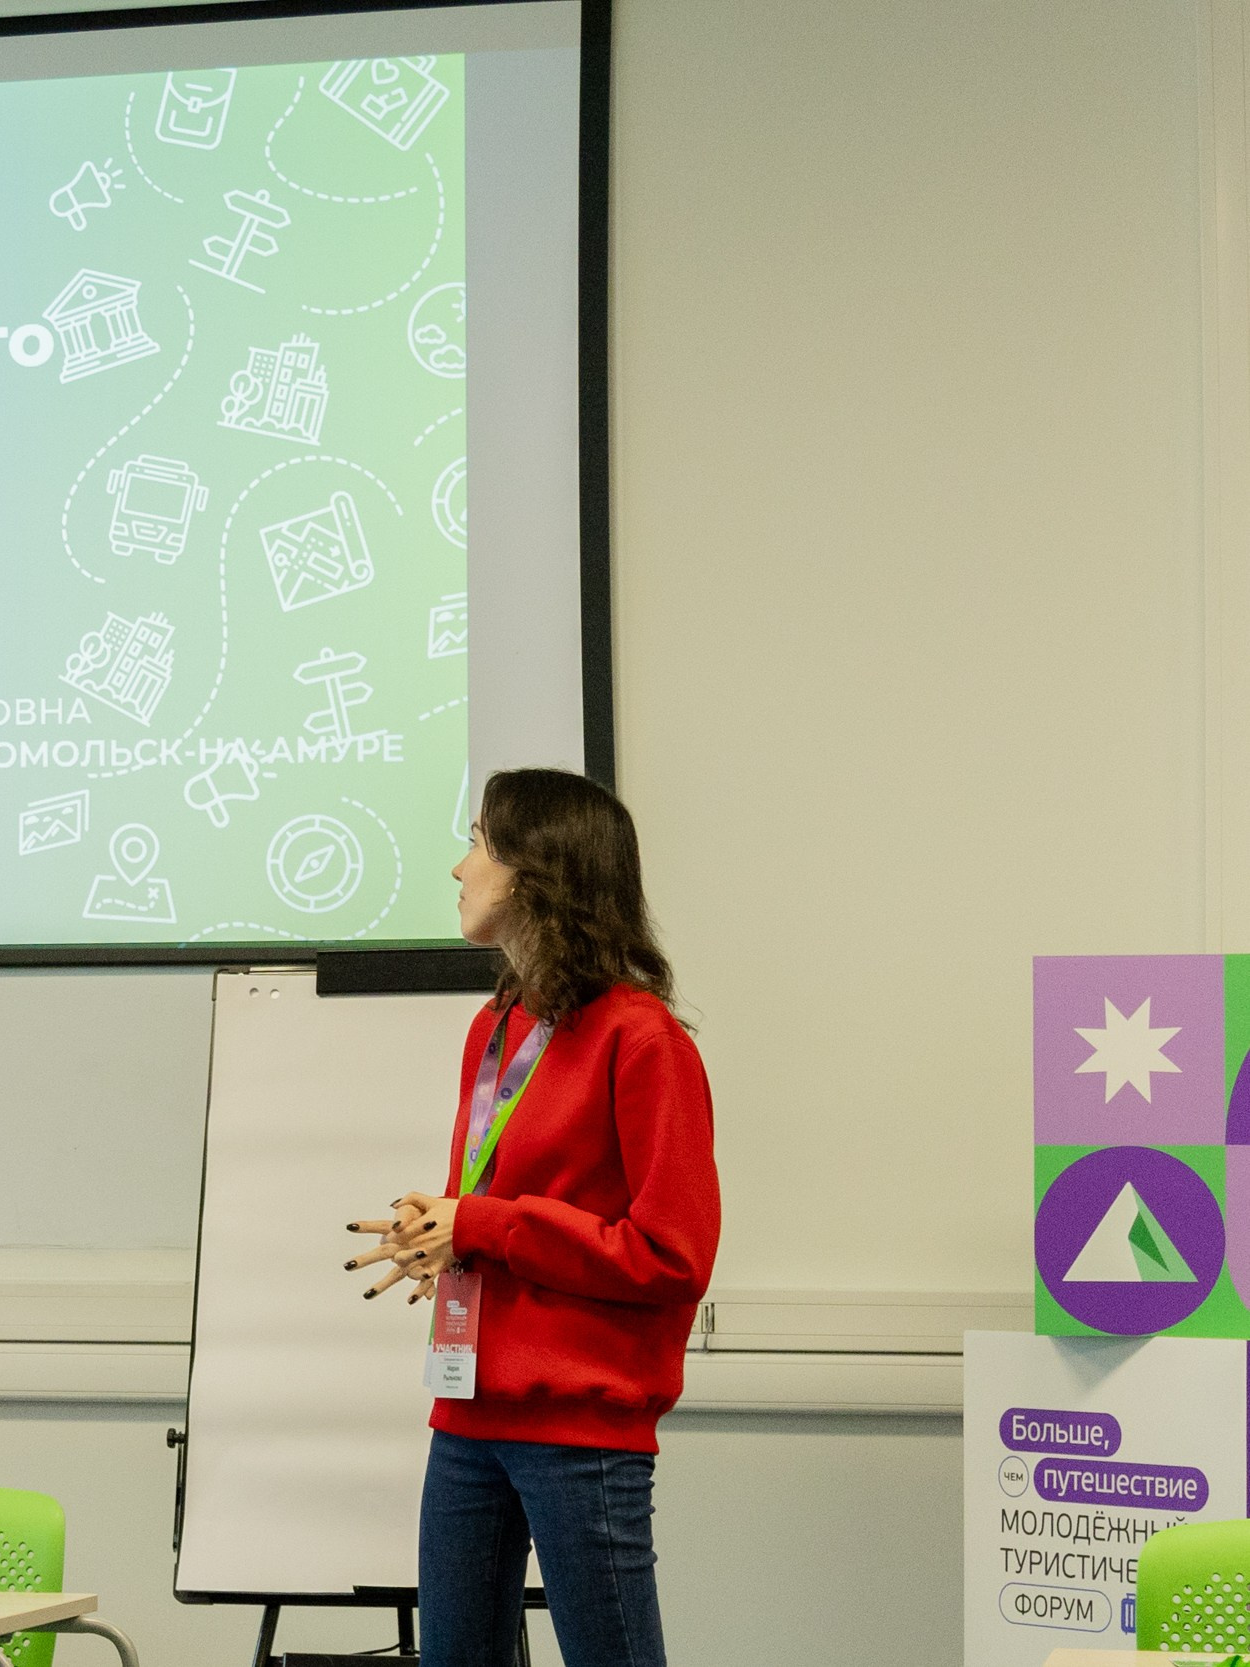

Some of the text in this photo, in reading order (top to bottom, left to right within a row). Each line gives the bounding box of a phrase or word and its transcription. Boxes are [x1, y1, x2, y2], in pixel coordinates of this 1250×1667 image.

[1012, 1415, 1110, 1450] Больше,
[1043, 1468, 1198, 1500] путешествие
[1001, 1508, 1189, 1545] МОЛОДЁЖН
[1000, 1547, 1137, 1584] ТУРИСТИЧЕ
[1014, 1593, 1094, 1622] ФОРУМ
